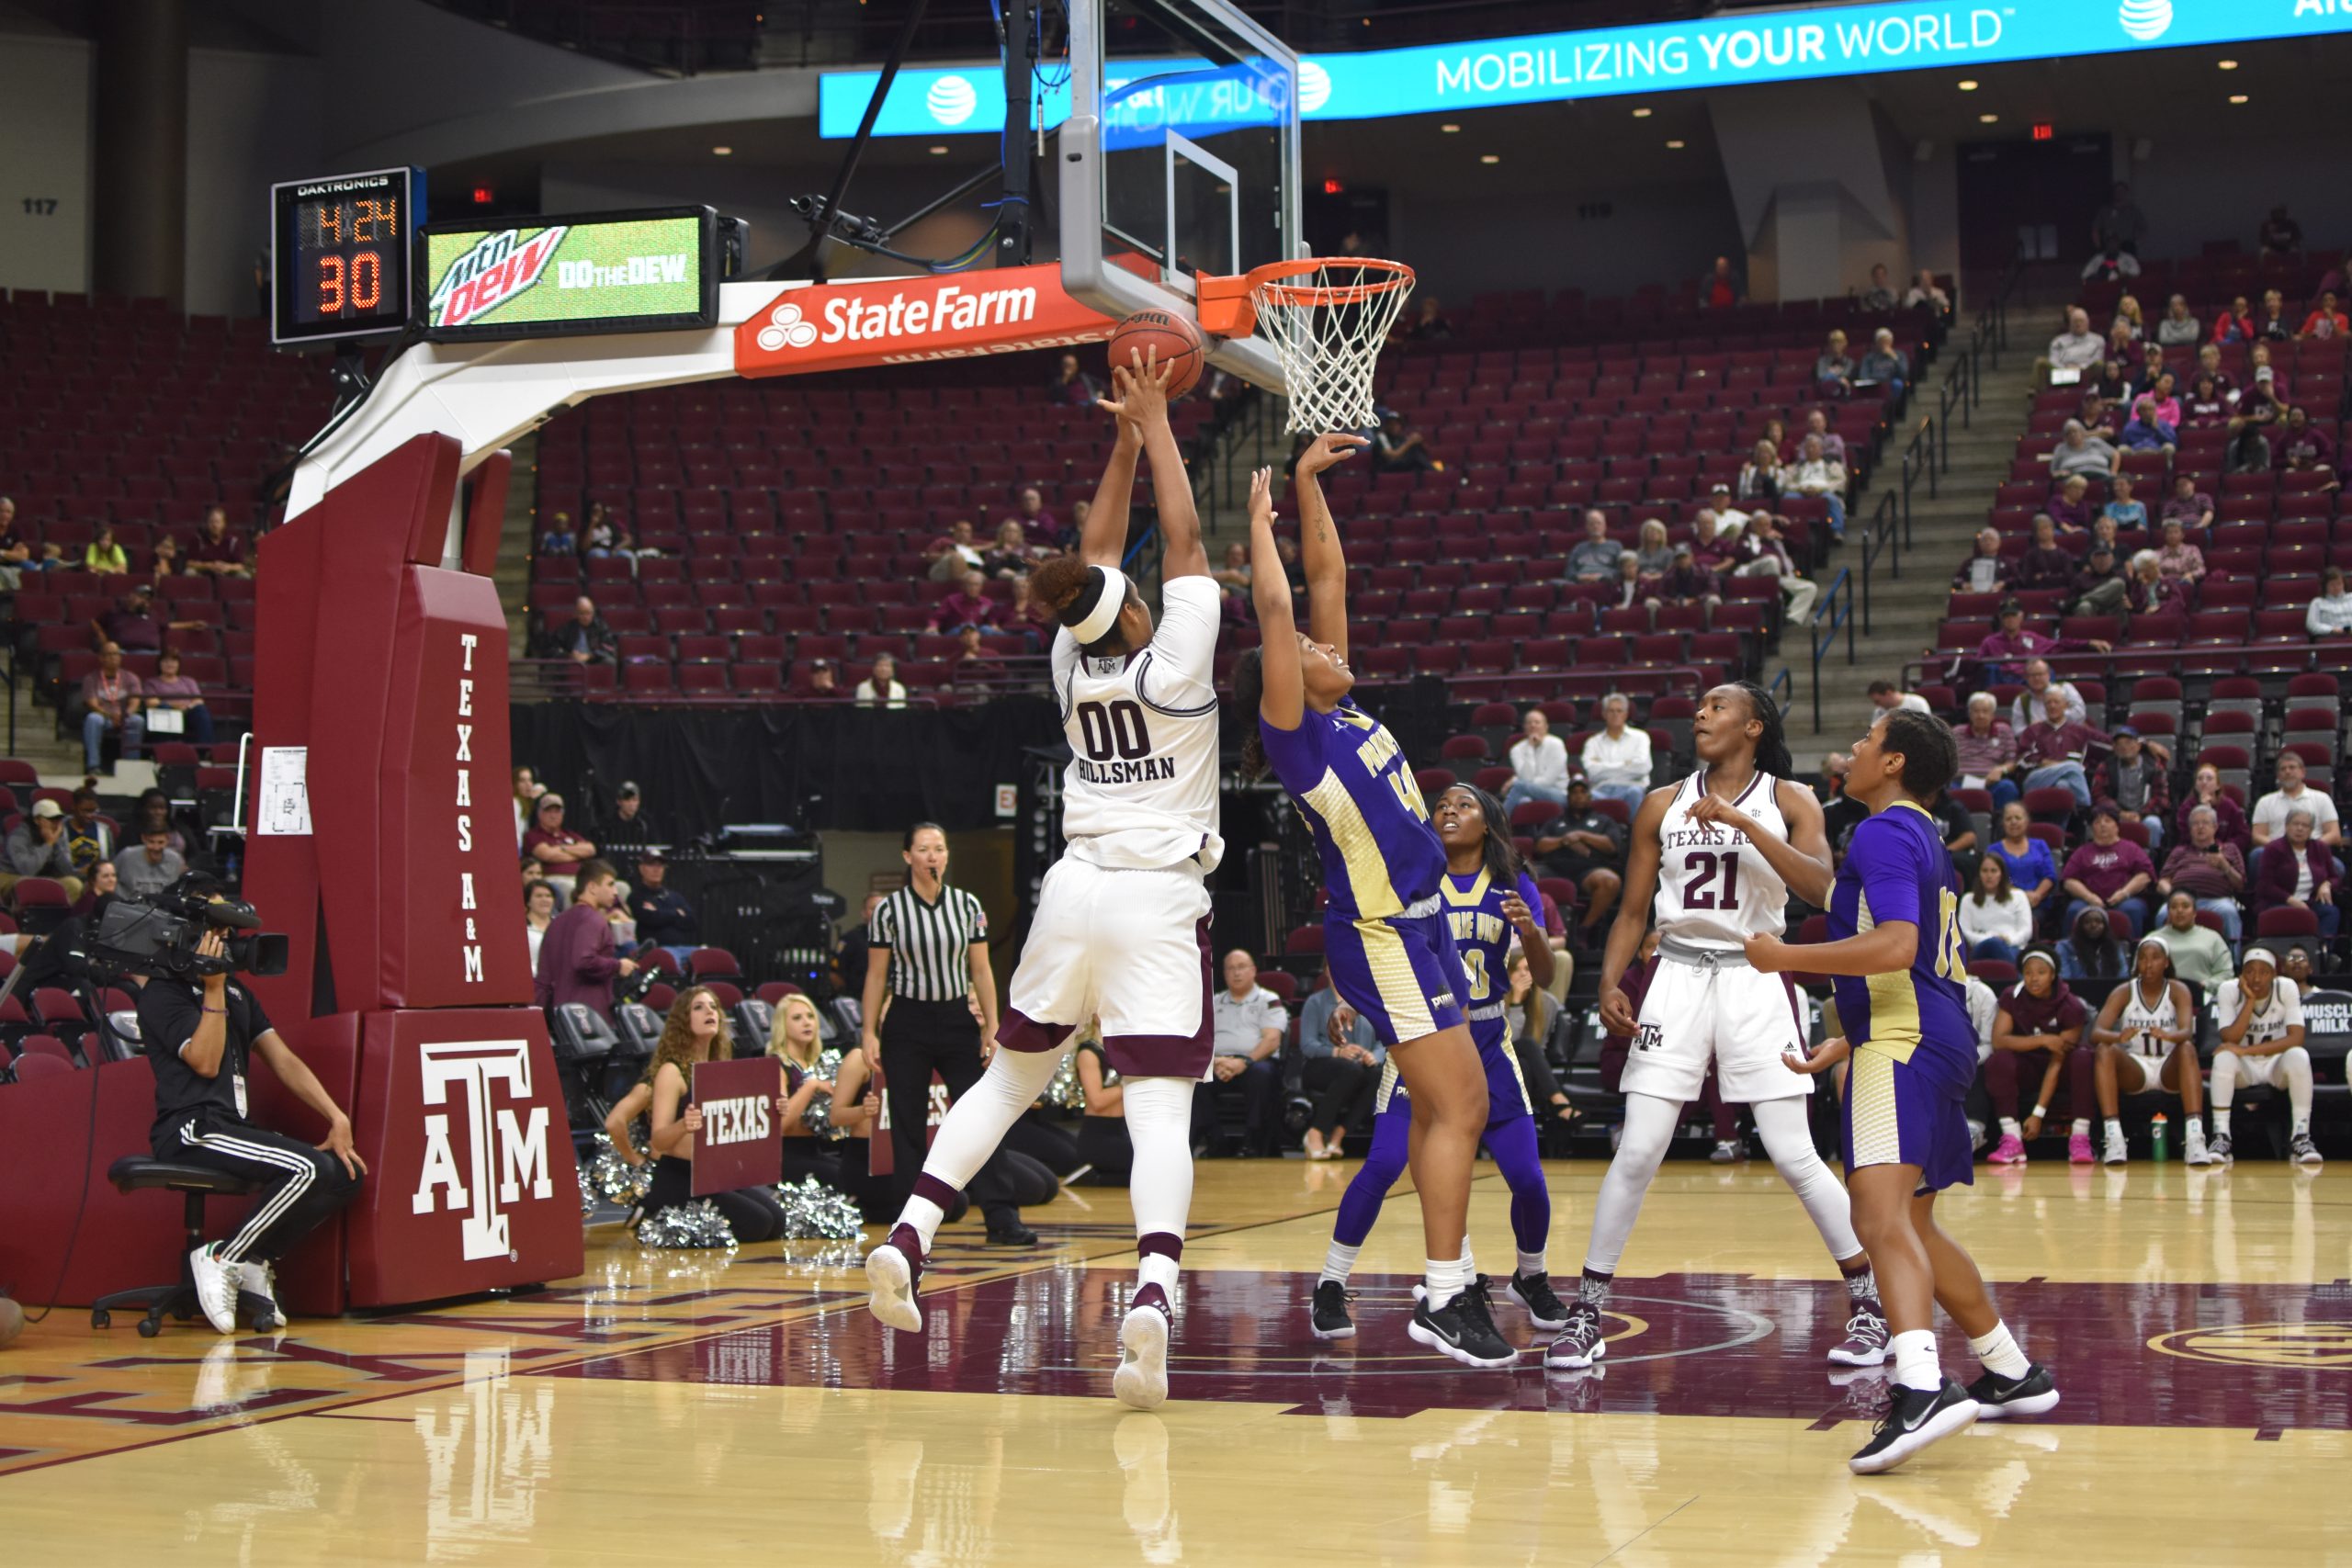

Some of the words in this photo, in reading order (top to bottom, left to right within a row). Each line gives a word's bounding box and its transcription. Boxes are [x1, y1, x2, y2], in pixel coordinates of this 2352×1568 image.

[1435, 36, 1689, 96] MOBILIZING
[1698, 24, 1826, 71] YOUR
[22, 197, 58, 215] 117
[297, 175, 390, 197] DAKTRONICS
[320, 252, 380, 313] 30
[456, 634, 478, 852] TEXAS
[1077, 699, 1152, 761] 00
[1079, 756, 1176, 784] HILLSMAN
[1667, 829, 1725, 849] TEXAS
[1683, 852, 1739, 910] 21
[2301, 1004, 2352, 1020] MUSCL
[2312, 1018, 2351, 1033] MILK
[702, 1094, 770, 1146] TEXAS
